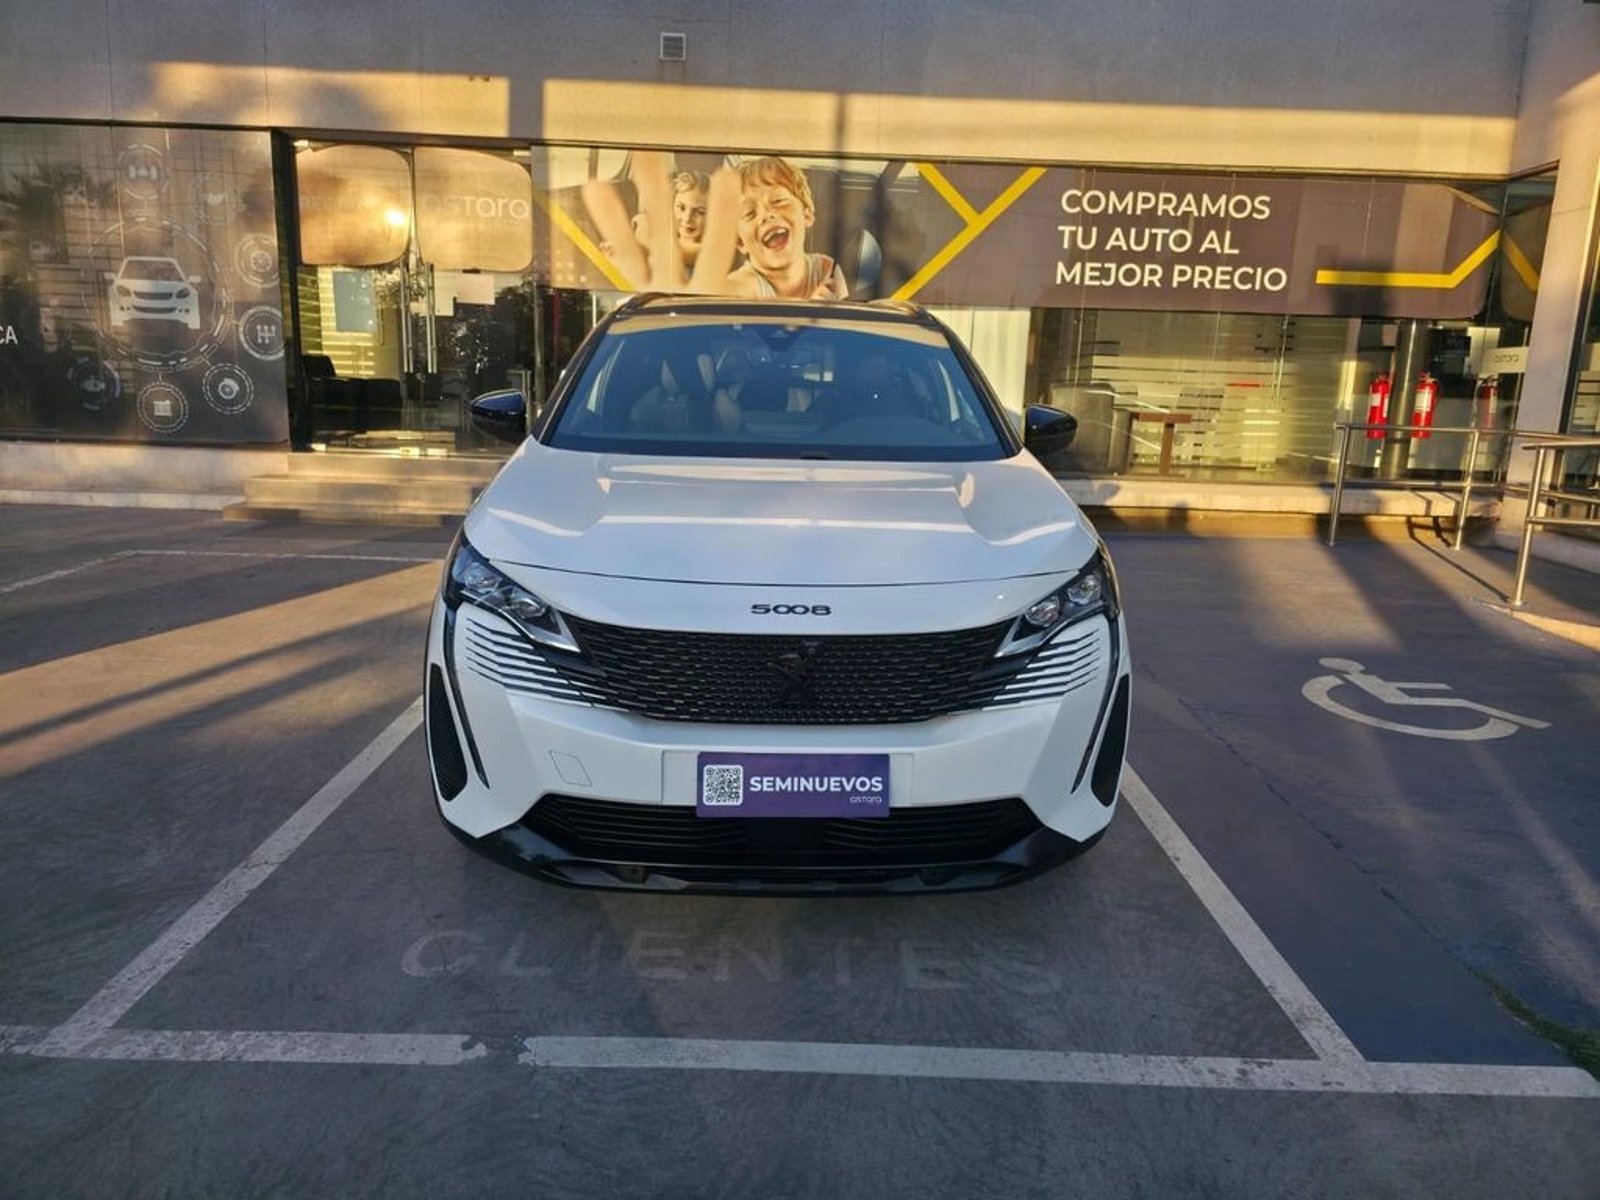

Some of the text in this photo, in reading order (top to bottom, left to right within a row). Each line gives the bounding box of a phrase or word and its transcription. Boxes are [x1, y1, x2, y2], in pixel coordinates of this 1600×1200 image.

[1060, 189, 1271, 220] COMPRAMOS
[1057, 225, 1240, 255] TU AUTO AL
[1055, 261, 1288, 292] MEJOR PRECIO
[750, 603, 832, 617] 5008
[749, 775, 884, 792] SEMINUEVOS
[401, 926, 1063, 995] CLIENTES
